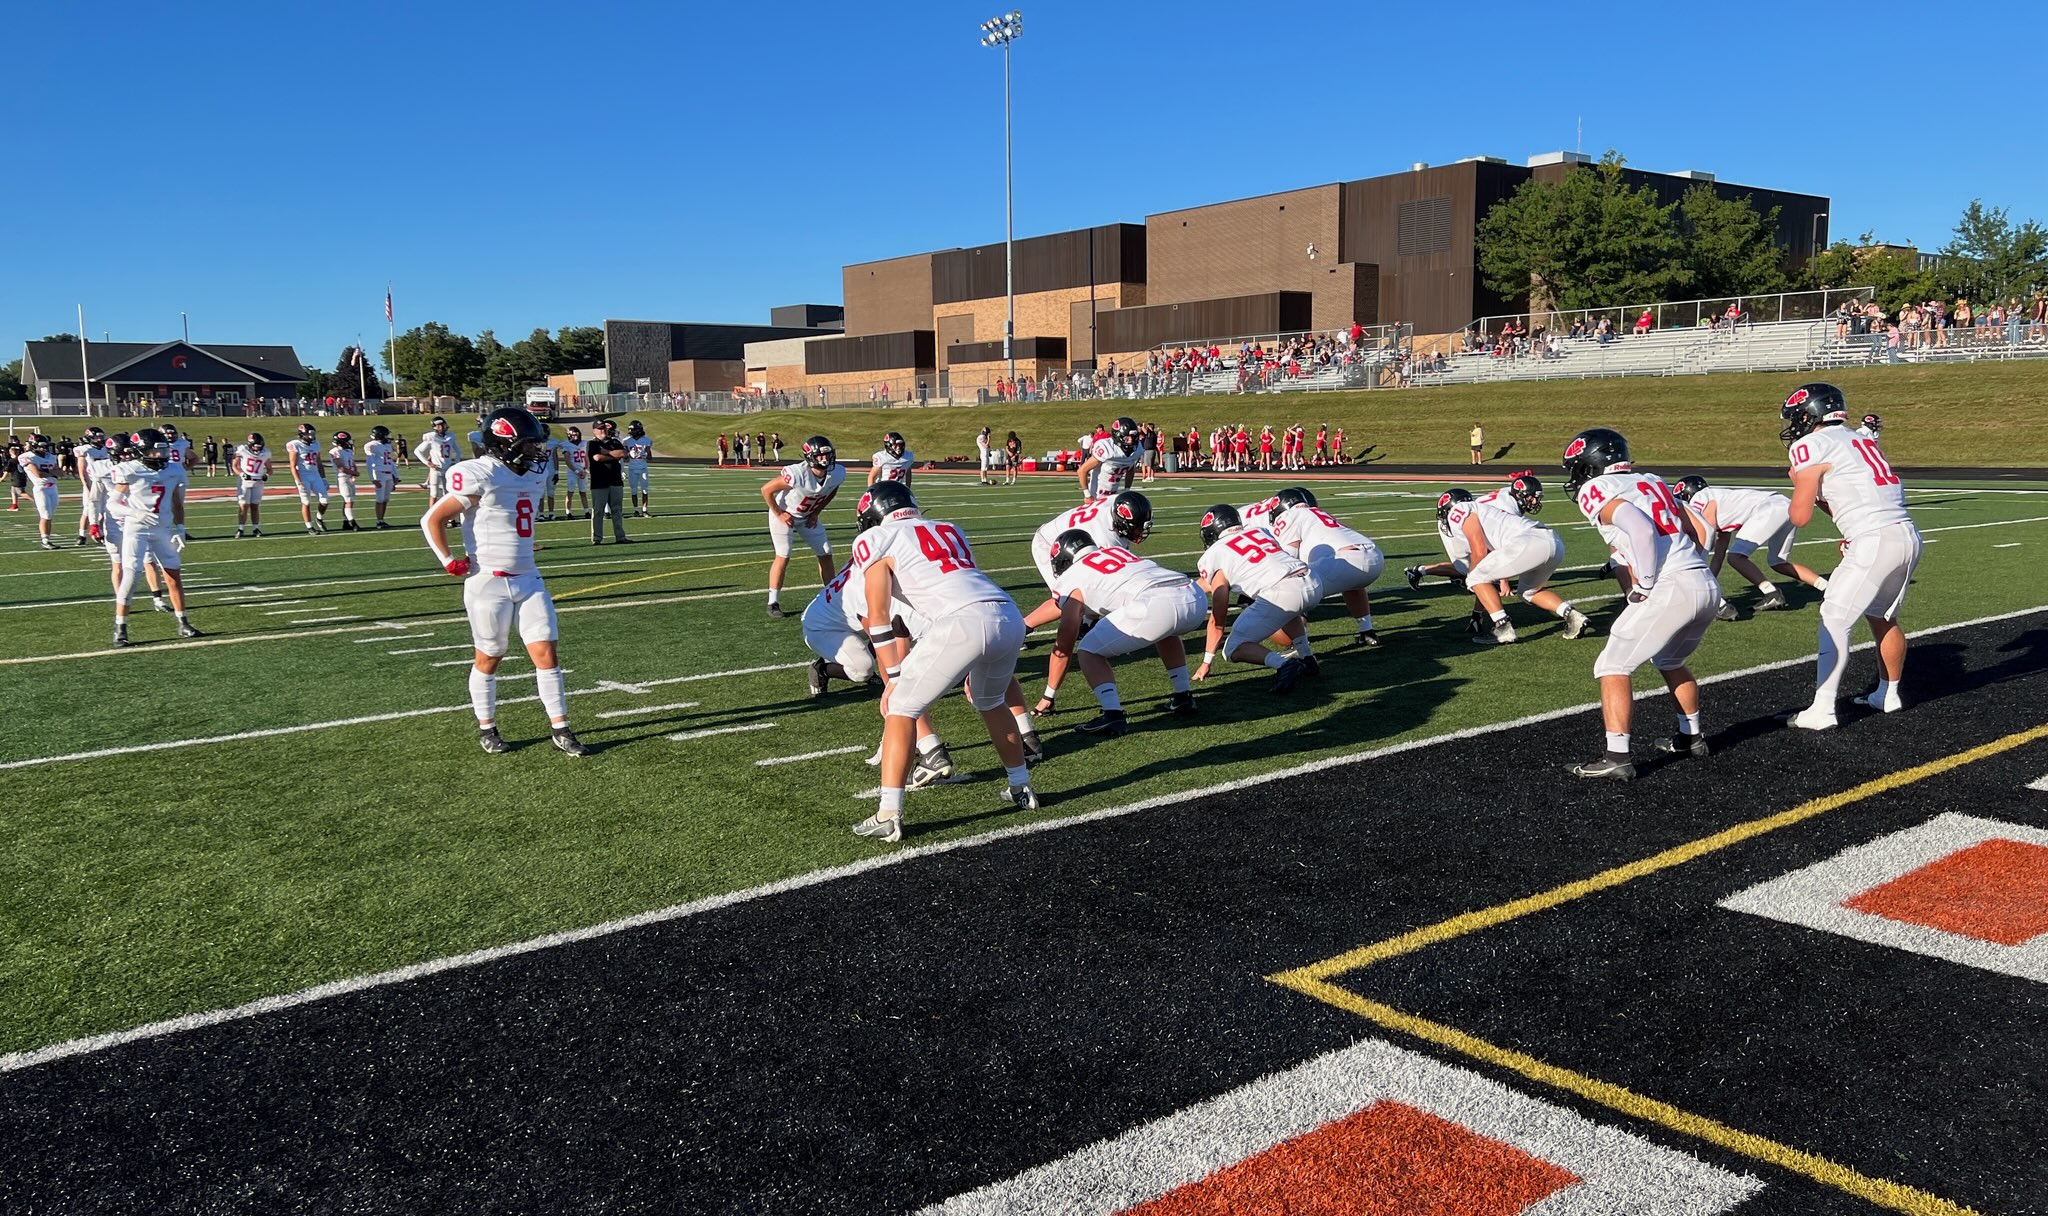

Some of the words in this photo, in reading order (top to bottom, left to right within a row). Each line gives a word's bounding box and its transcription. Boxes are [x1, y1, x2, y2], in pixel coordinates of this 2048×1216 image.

[246, 458, 263, 474] 57
[1791, 444, 1810, 466] 10
[1852, 439, 1900, 486] 10
[452, 472, 463, 491] 8
[151, 485, 166, 513] 7
[1581, 484, 1606, 515] 24
[516, 499, 534, 538] 8
[1450, 508, 1466, 524] 61
[914, 524, 976, 574] 40
[1226, 529, 1281, 564] 55
[1082, 547, 1142, 575] 60
